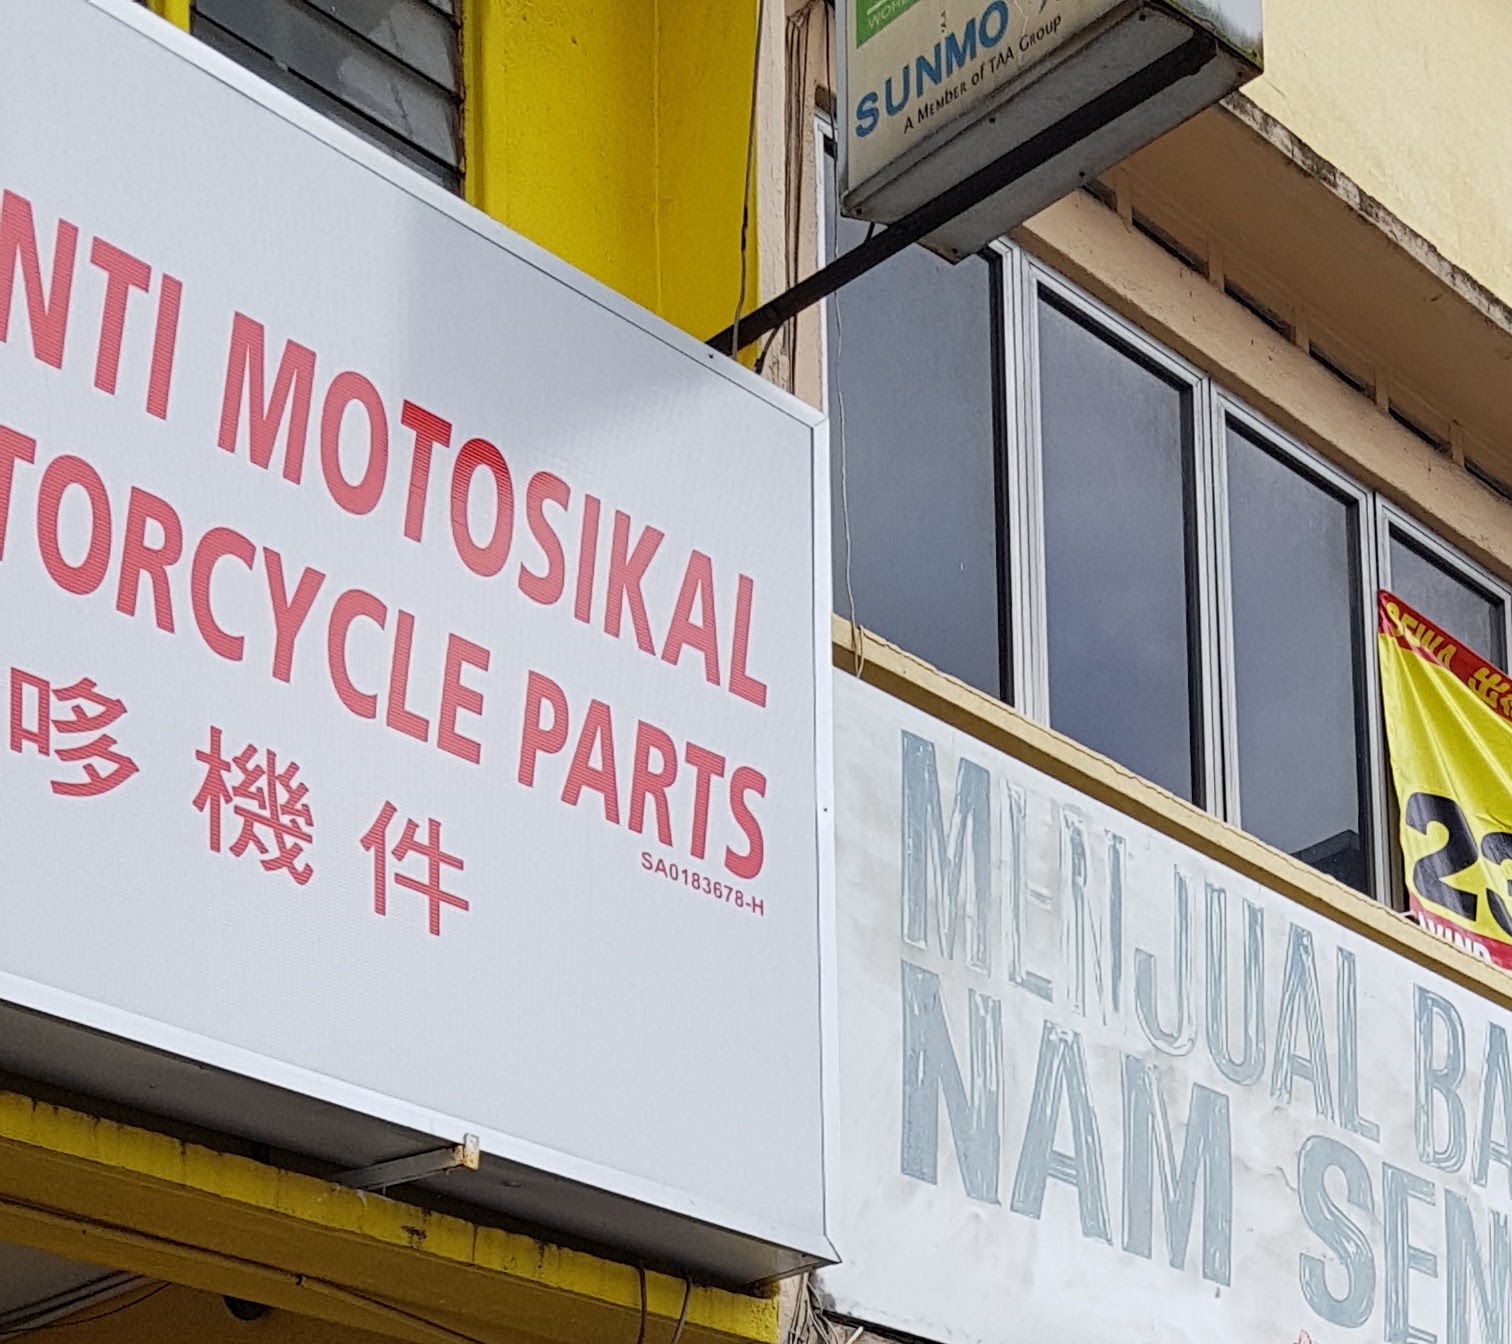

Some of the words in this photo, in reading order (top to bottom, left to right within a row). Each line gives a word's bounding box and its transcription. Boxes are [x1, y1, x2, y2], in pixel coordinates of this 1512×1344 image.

[903, 116, 915, 135] A
[971, 63, 985, 86] of
[985, 46, 1015, 74] TAA
[217, 311, 768, 709] MOTOSIKAL
[517, 669, 768, 880] PARTS
[641, 852, 765, 916] SA0183678-H
[901, 728, 1380, 1142] MENJUAL
[900, 959, 1233, 1288] NAM
